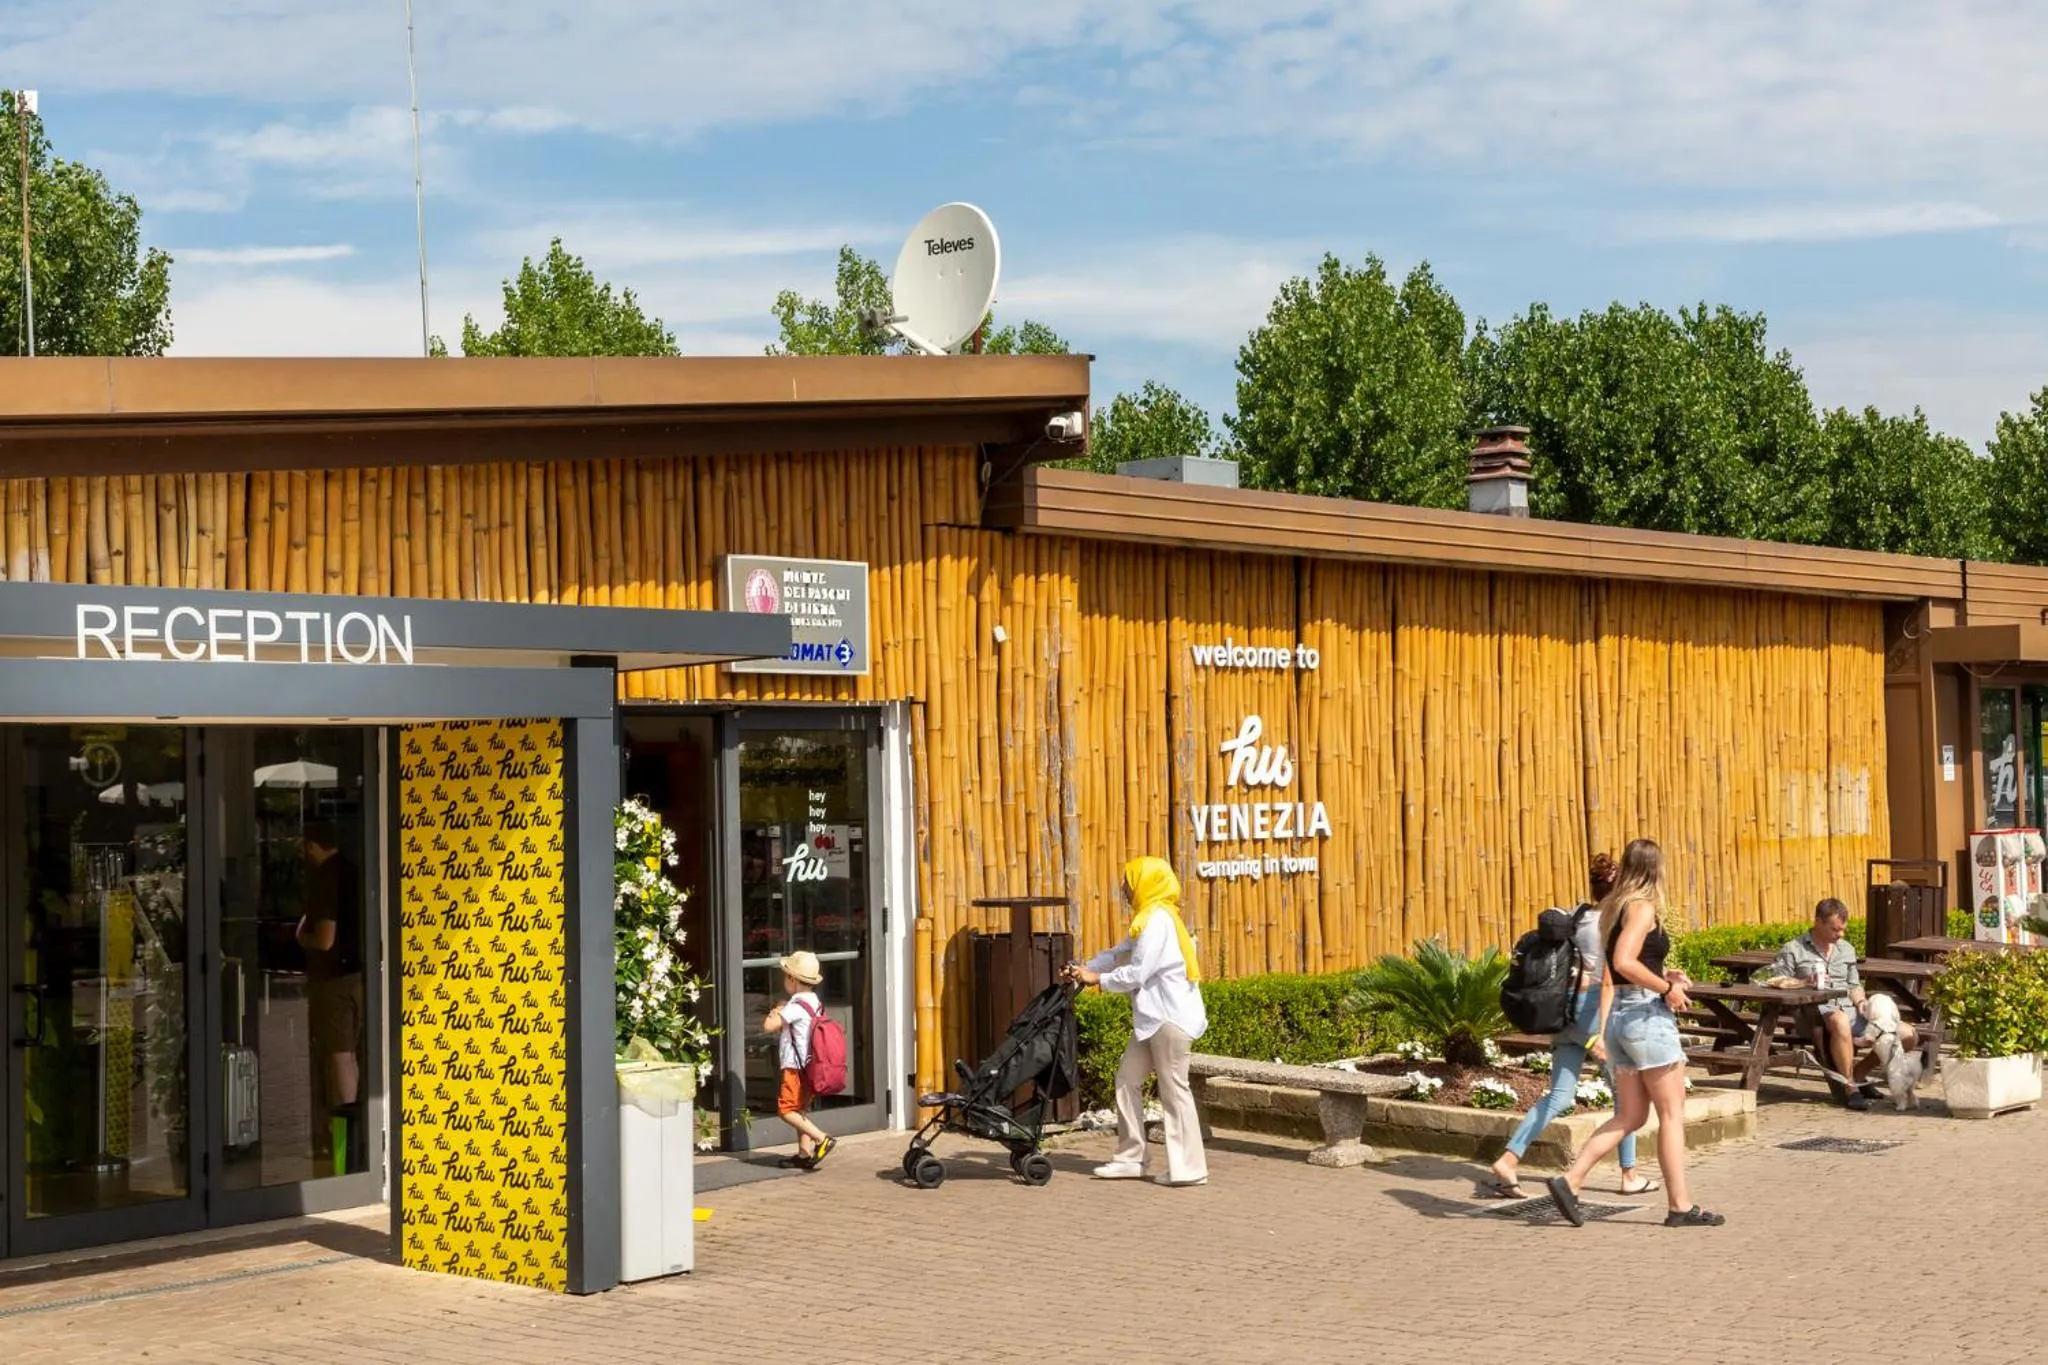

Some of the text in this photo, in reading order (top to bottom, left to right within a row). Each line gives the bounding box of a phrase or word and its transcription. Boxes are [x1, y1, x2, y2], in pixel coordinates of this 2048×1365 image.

[924, 238, 974, 255] Televes
[76, 604, 414, 664] RECEPTION
[787, 643, 833, 661] OMAT
[1193, 637, 1320, 669] welcome to
[406, 738, 422, 754] hu
[432, 735, 448, 752] hu
[462, 736, 478, 752] hu
[488, 733, 505, 750] hu
[519, 734, 537, 751] hu
[1220, 714, 1293, 787] hu
[415, 749, 550, 780] hu hu hu hu hu
[406, 787, 422, 804] hu
[432, 784, 448, 801] hu
[462, 787, 478, 803] hu
[488, 783, 505, 800] hu
[520, 786, 536, 802] hu
[809, 789, 826, 803] hey
[416, 800, 551, 830] hu hu hu hu hu
[809, 805, 826, 819] hey
[1191, 801, 1332, 842] VENEZIA
[809, 821, 826, 834] hey
[406, 836, 422, 853] hu
[432, 834, 448, 850] hu
[462, 836, 479, 853] hu
[488, 834, 506, 851] hu
[520, 837, 537, 854] hu
[416, 850, 551, 881] hu hu hu hu hu
[782, 843, 828, 883] hu
[1197, 853, 1318, 880] camping in town
[407, 886, 422, 902] hu
[432, 884, 449, 900] hu
[462, 887, 479, 904] hu
[489, 885, 506, 902] hu
[521, 888, 536, 904] hu
[416, 900, 552, 932] hu hu hu hu hu
[407, 936, 424, 952] hu
[433, 933, 449, 950] hu
[490, 936, 506, 952] hu
[522, 940, 538, 956] hu
[417, 950, 552, 984] hu hu hu hu hu
[408, 984, 423, 1001] hu
[434, 983, 450, 1000] hu
[464, 988, 480, 1004] hu
[490, 986, 506, 1004] hu
[522, 991, 538, 1008] hu
[417, 1000, 552, 1035] hu hu hu hu hu
[408, 1034, 423, 1050] hu
[434, 1033, 449, 1050] hu
[464, 1038, 480, 1054] hu
[491, 1038, 507, 1054] hu
[522, 1042, 538, 1059] hu
[417, 1051, 553, 1086] hu hu hu hu hu
[408, 1084, 423, 1100] hu
[434, 1083, 450, 1100] hu
[464, 1088, 480, 1105] hu
[491, 1088, 507, 1106] hu
[522, 1094, 539, 1111] hu
[418, 1101, 553, 1138] hu hu hu hu hu
[408, 1134, 423, 1150] hu
[434, 1134, 450, 1150] hu
[464, 1140, 480, 1156] hu
[492, 1140, 508, 1157] hu
[522, 1146, 539, 1163] hu
[418, 1152, 553, 1190] hu hu hu hu hu
[408, 1183, 423, 1200] hu
[434, 1184, 450, 1201] hu
[464, 1190, 480, 1207] hu
[492, 1191, 508, 1208] hu
[522, 1198, 539, 1215] hu
[418, 1202, 554, 1242] hu hu hu hu hu
[408, 1233, 424, 1250] hu
[434, 1234, 450, 1251] hu
[465, 1241, 480, 1258] hu
[492, 1242, 508, 1260] hu
[523, 1250, 540, 1267] hu
